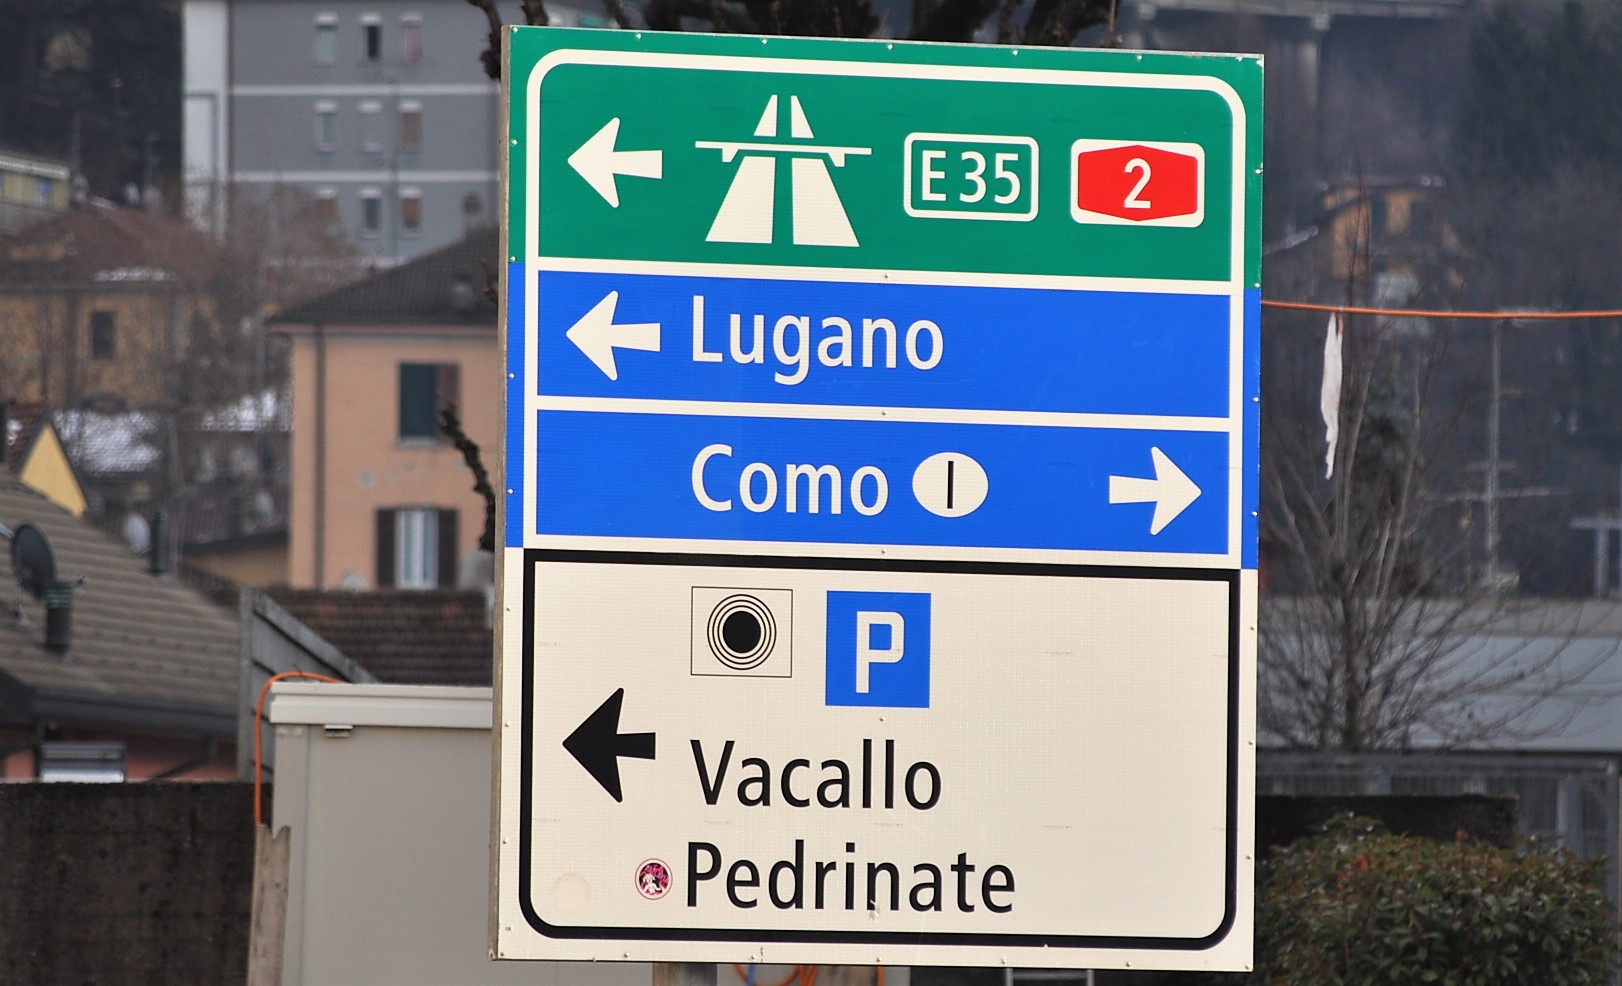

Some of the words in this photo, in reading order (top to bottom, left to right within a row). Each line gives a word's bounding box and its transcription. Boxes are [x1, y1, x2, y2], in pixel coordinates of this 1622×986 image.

[1124, 158, 1151, 209] 2
[692, 295, 944, 386] Lugano
[691, 443, 889, 516] Como
[855, 610, 905, 694] P
[690, 738, 942, 811] Vacallo
[687, 839, 1015, 914] Pedrinate
